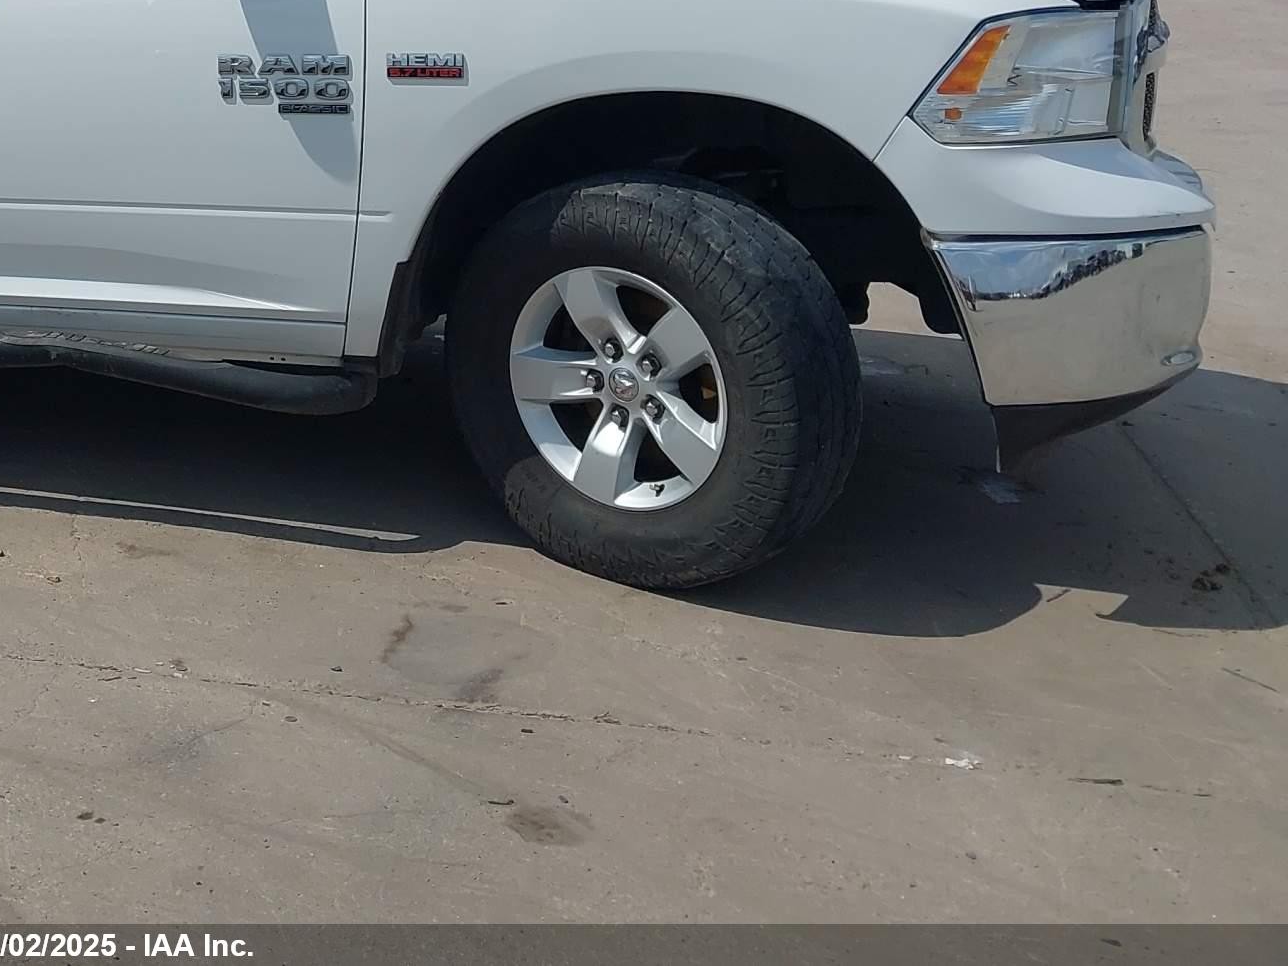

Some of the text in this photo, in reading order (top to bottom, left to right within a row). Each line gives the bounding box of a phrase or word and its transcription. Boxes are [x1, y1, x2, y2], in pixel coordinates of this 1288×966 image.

[217, 54, 350, 76] RAM
[386, 52, 464, 67] HEMI
[389, 68, 461, 78] 5.7 LITER
[217, 77, 349, 100] 1500
[279, 104, 349, 113] CLASSIC
